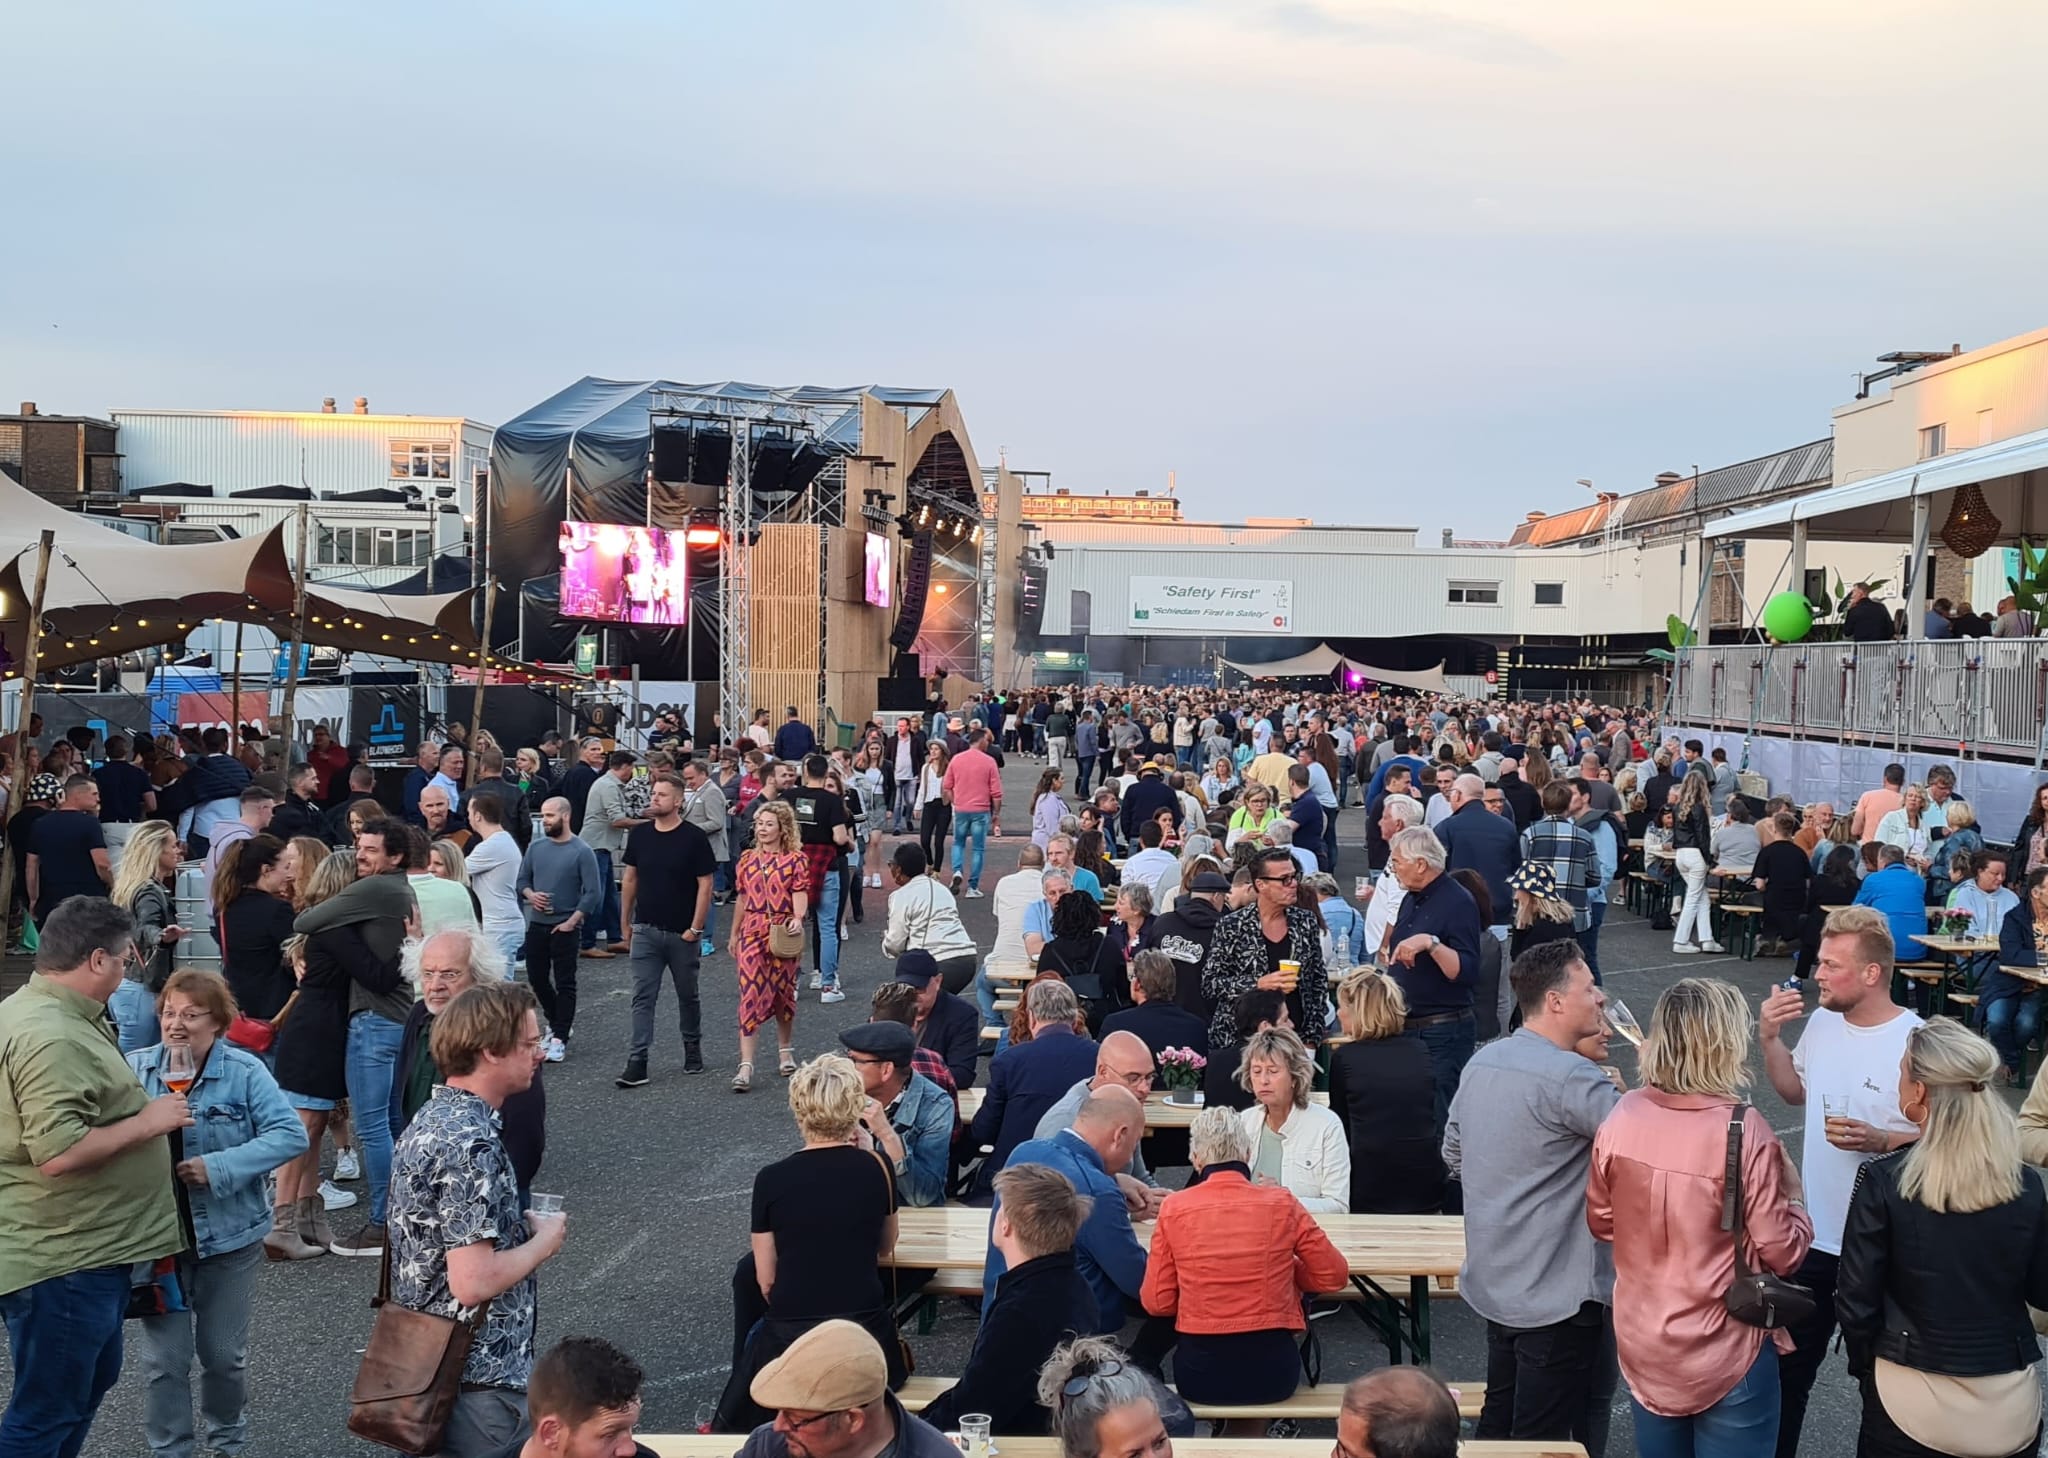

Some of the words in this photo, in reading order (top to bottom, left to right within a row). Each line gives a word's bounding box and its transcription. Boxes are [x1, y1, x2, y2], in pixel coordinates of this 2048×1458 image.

[1162, 585, 1216, 601] "Safety
[1220, 587, 1261, 600] First"
[1153, 606, 1200, 616] "Schiedam
[1202, 608, 1225, 617] First
[1225, 609, 1234, 617] in
[1235, 609, 1269, 619] Safety"
